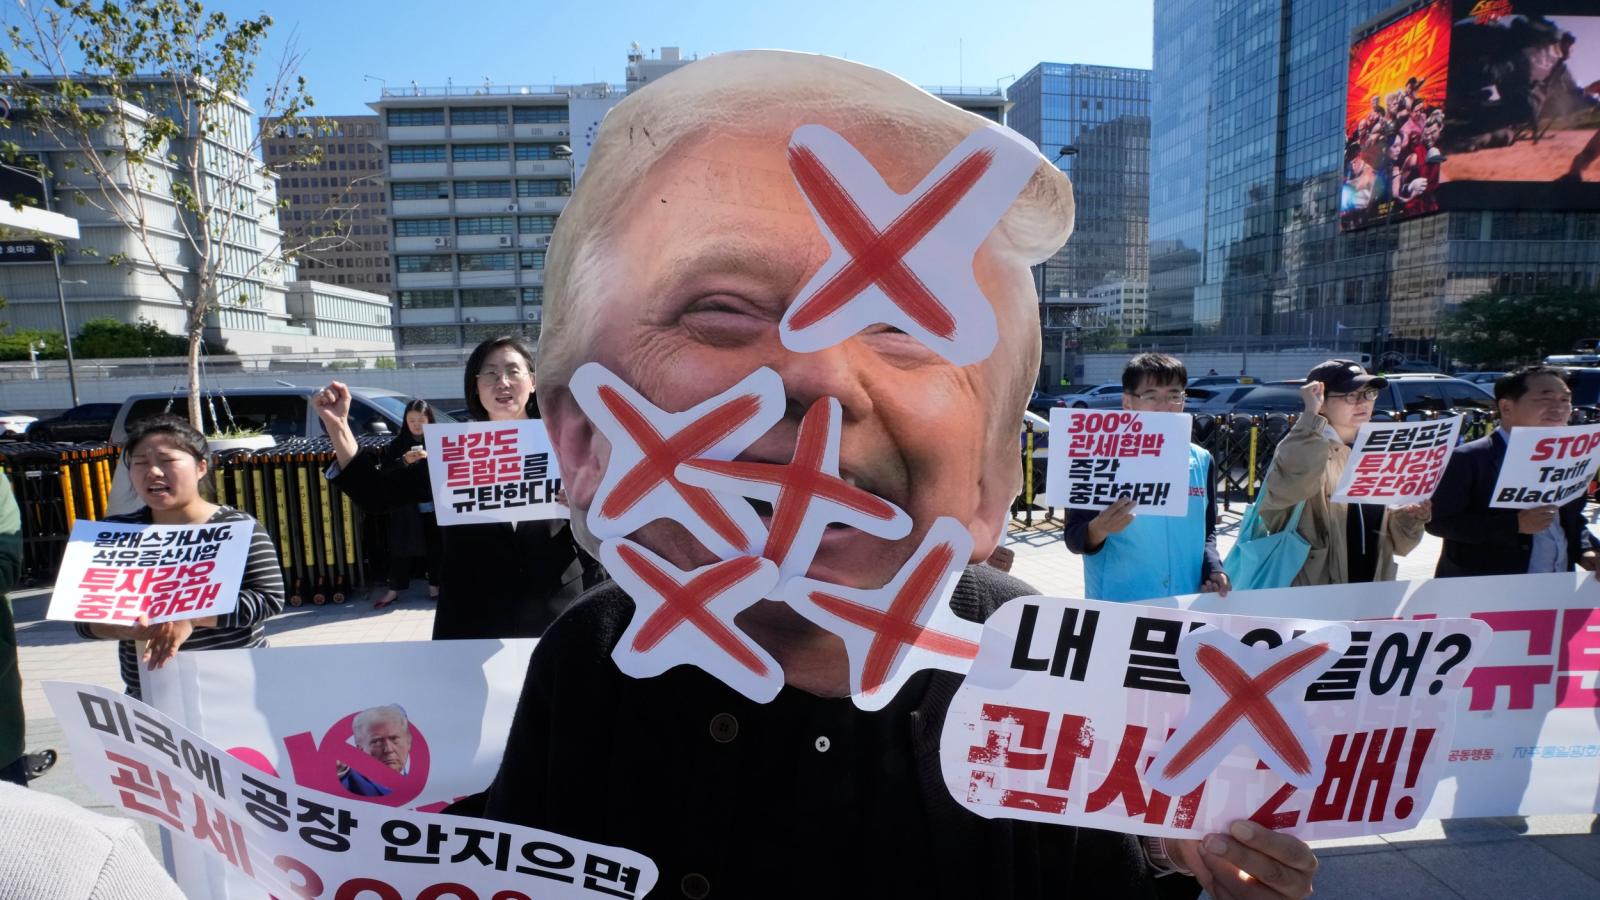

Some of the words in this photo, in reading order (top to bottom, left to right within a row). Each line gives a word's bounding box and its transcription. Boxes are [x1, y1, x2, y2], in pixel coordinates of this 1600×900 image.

[1068, 413, 1143, 433] 300%
[1361, 422, 1453, 452] 트럼프는
[442, 429, 518, 462] 날강도
[1068, 434, 1165, 457] 관세협박
[1355, 445, 1447, 475] 투자강요
[1530, 431, 1600, 461] STOP
[447, 453, 548, 487] 트럼프를
[1069, 459, 1120, 481] 즉각
[1539, 458, 1591, 483] Tariff
[452, 478, 561, 513] 규탄한다!
[1069, 483, 1170, 505] 중단하라!
[92, 544, 220, 567] 석유증산사업
[78, 561, 216, 594] 투자강요
[74, 583, 222, 620] 중단하라!
[1010, 604, 1100, 682] 내
[77, 691, 226, 800] 미국에
[241, 772, 358, 852] 공장
[380, 819, 641, 900] 안지으면
[104, 750, 255, 879] 관세
